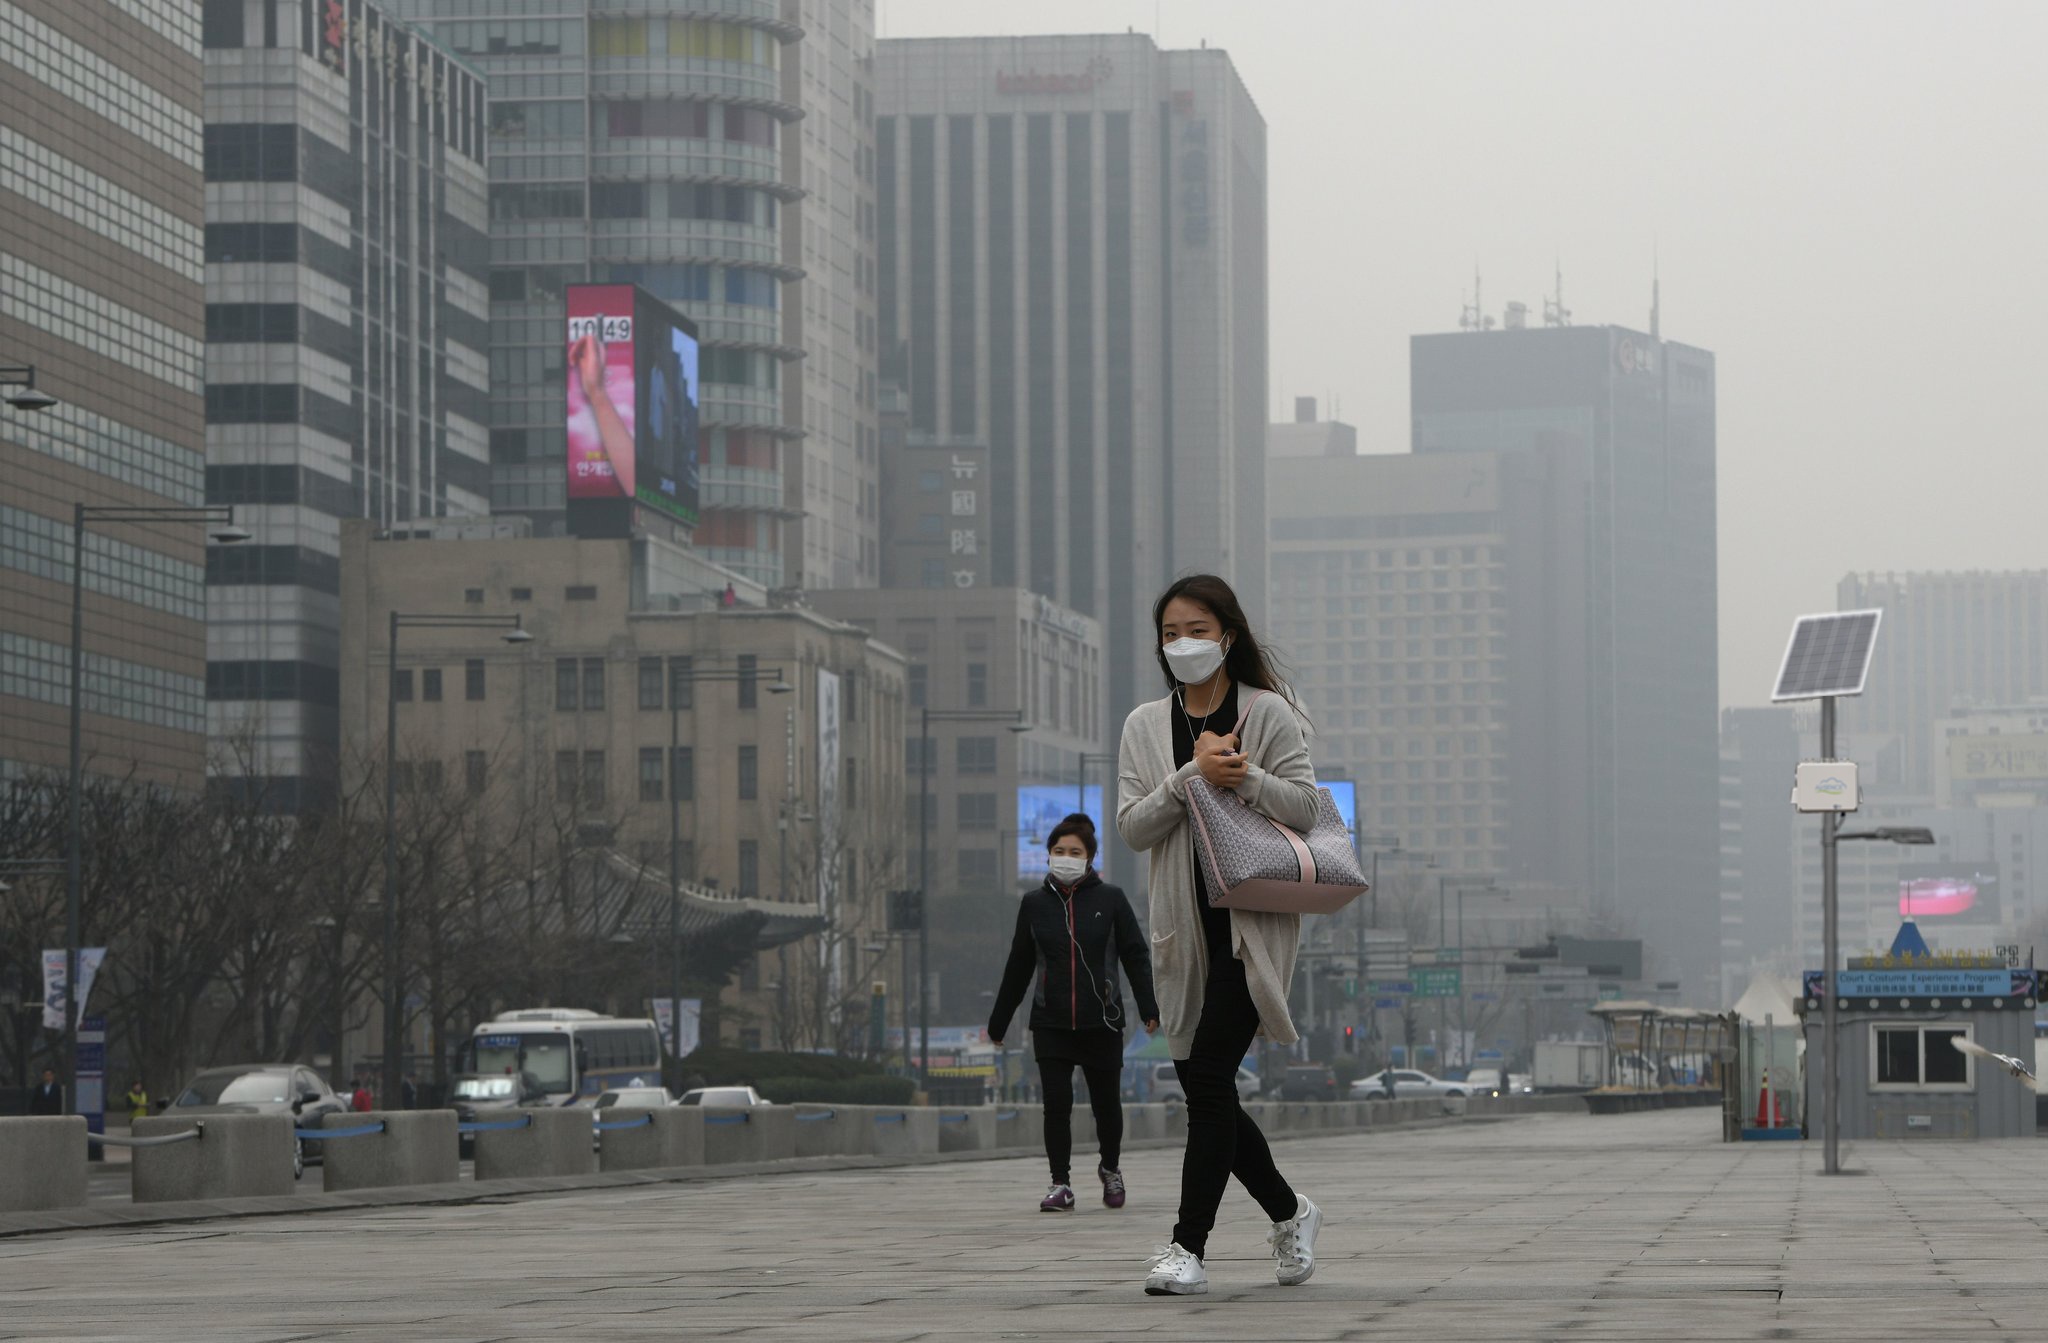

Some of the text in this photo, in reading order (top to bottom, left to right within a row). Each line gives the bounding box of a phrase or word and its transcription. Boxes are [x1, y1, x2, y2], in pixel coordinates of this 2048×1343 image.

[1839, 974, 2001, 984] Court Costume Experience Program
